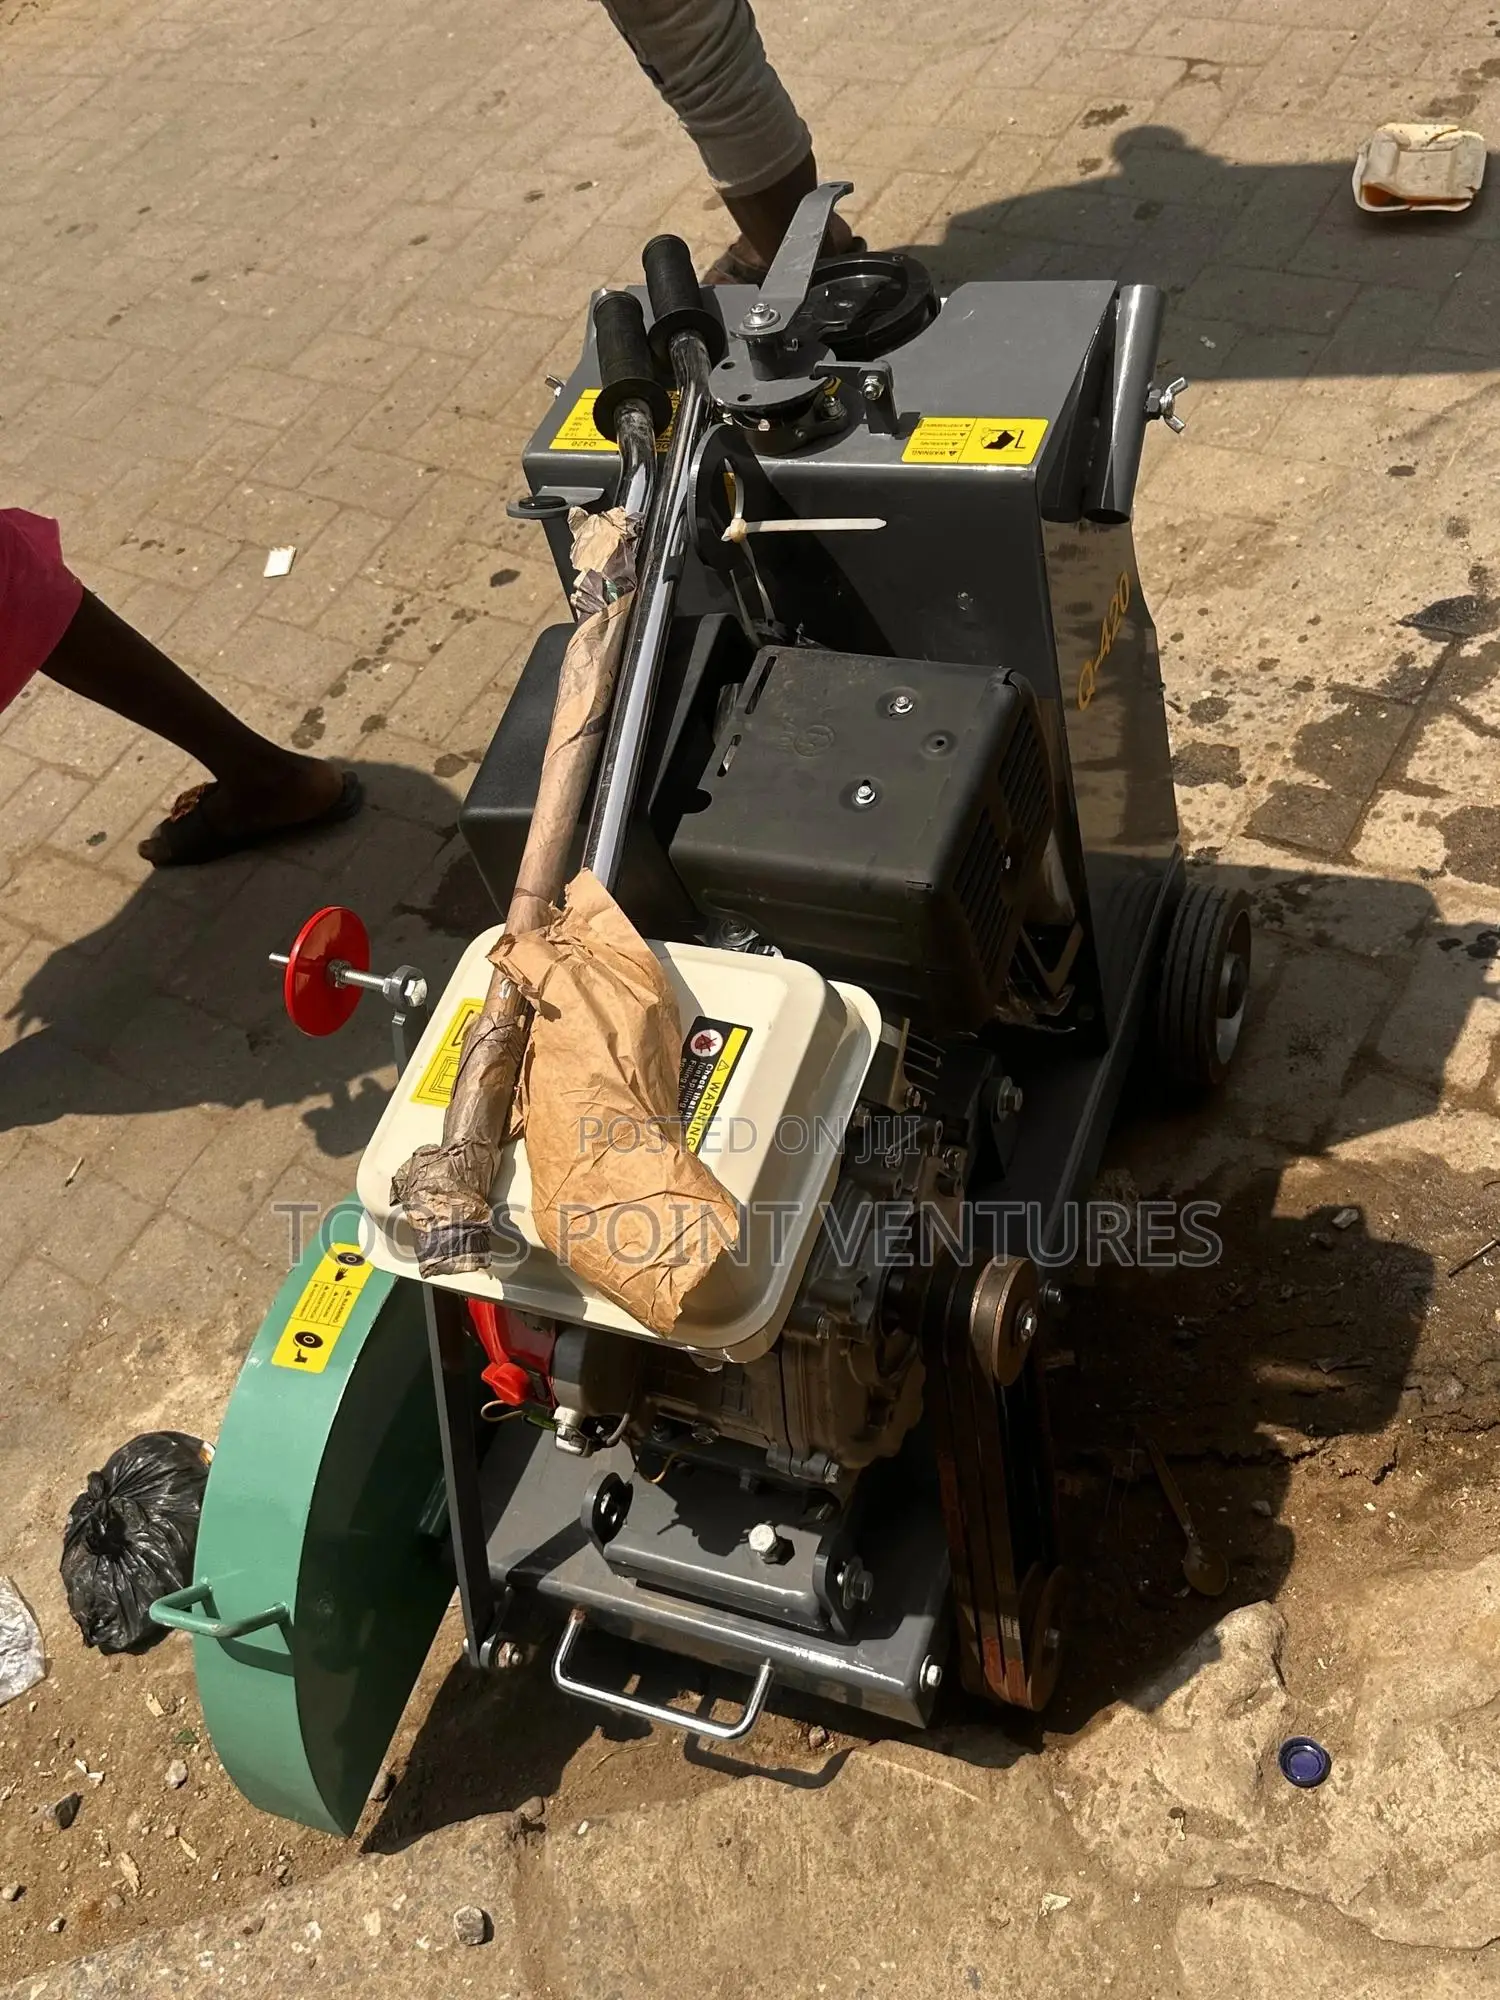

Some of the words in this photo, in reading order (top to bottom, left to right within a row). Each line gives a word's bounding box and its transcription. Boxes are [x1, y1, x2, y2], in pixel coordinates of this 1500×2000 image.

[1078, 571, 1130, 711] Q-420
[697, 1063, 714, 1090] Check
[686, 1081, 722, 1147] WARNING
[687, 1092, 701, 1109] that
